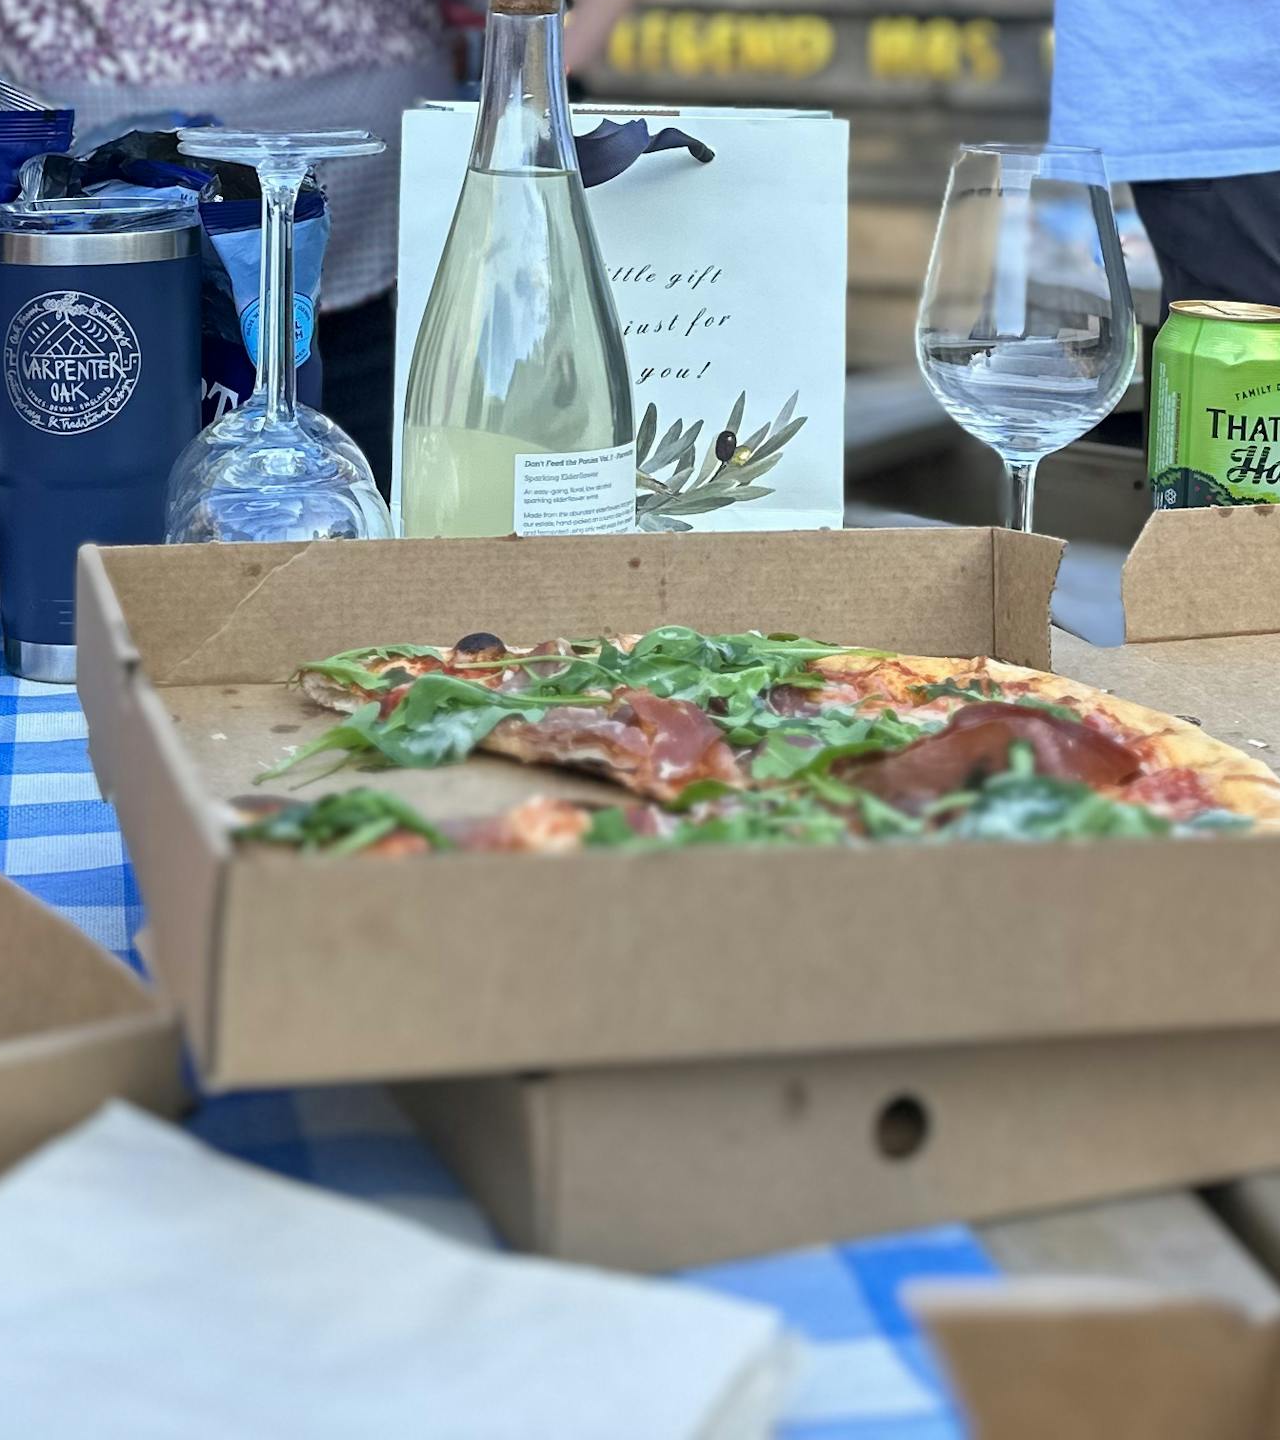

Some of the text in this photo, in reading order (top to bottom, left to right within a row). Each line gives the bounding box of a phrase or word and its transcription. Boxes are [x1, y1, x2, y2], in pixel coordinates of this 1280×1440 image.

[608, 264, 657, 283] ttle
[664, 264, 723, 290] gift
[89, 301, 133, 350] Buildings
[623, 307, 732, 337] just for
[22, 350, 127, 381] CARPENTER
[635, 361, 712, 385] you!
[50, 381, 90, 403] OAK
[1235, 384, 1272, 401] FAMILY
